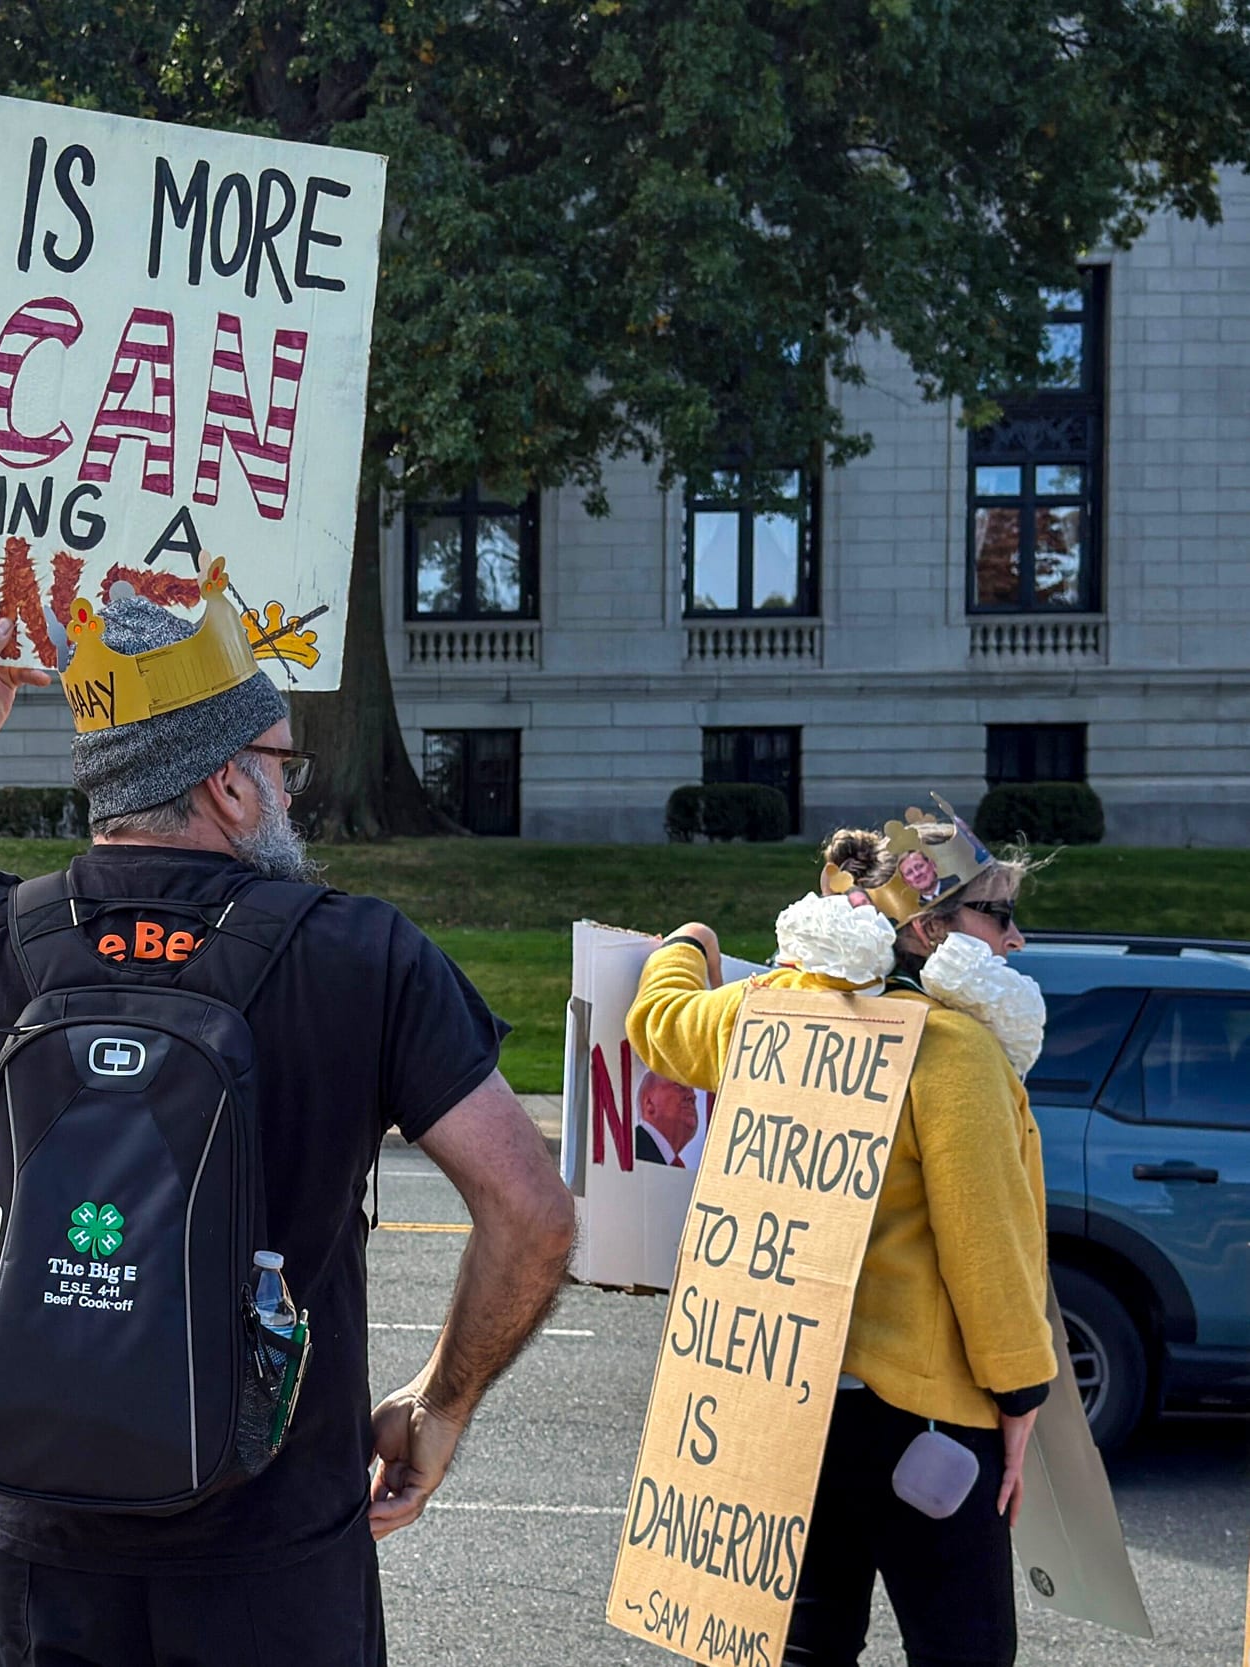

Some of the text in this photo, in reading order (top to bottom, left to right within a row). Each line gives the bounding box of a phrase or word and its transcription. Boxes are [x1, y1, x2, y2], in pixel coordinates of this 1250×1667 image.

[17, 136, 96, 274] IS
[148, 156, 352, 305] MORE
[143, 505, 201, 573] A
[134, 921, 204, 961] Be
[733, 1018, 904, 1103] FOR TRUE
[723, 1107, 889, 1200] PATRIOTS
[48, 1258, 137, 1284] The Big E
[693, 1203, 810, 1287] TO BE
[44, 1292, 133, 1311] Beef Cook-off
[98, 1285, 120, 1298] 4-H
[671, 1285, 819, 1404] SILENT,
[676, 1392, 718, 1466] IS
[628, 1476, 805, 1601] DANGEROUS
[696, 1612, 771, 1667] ADAMS
